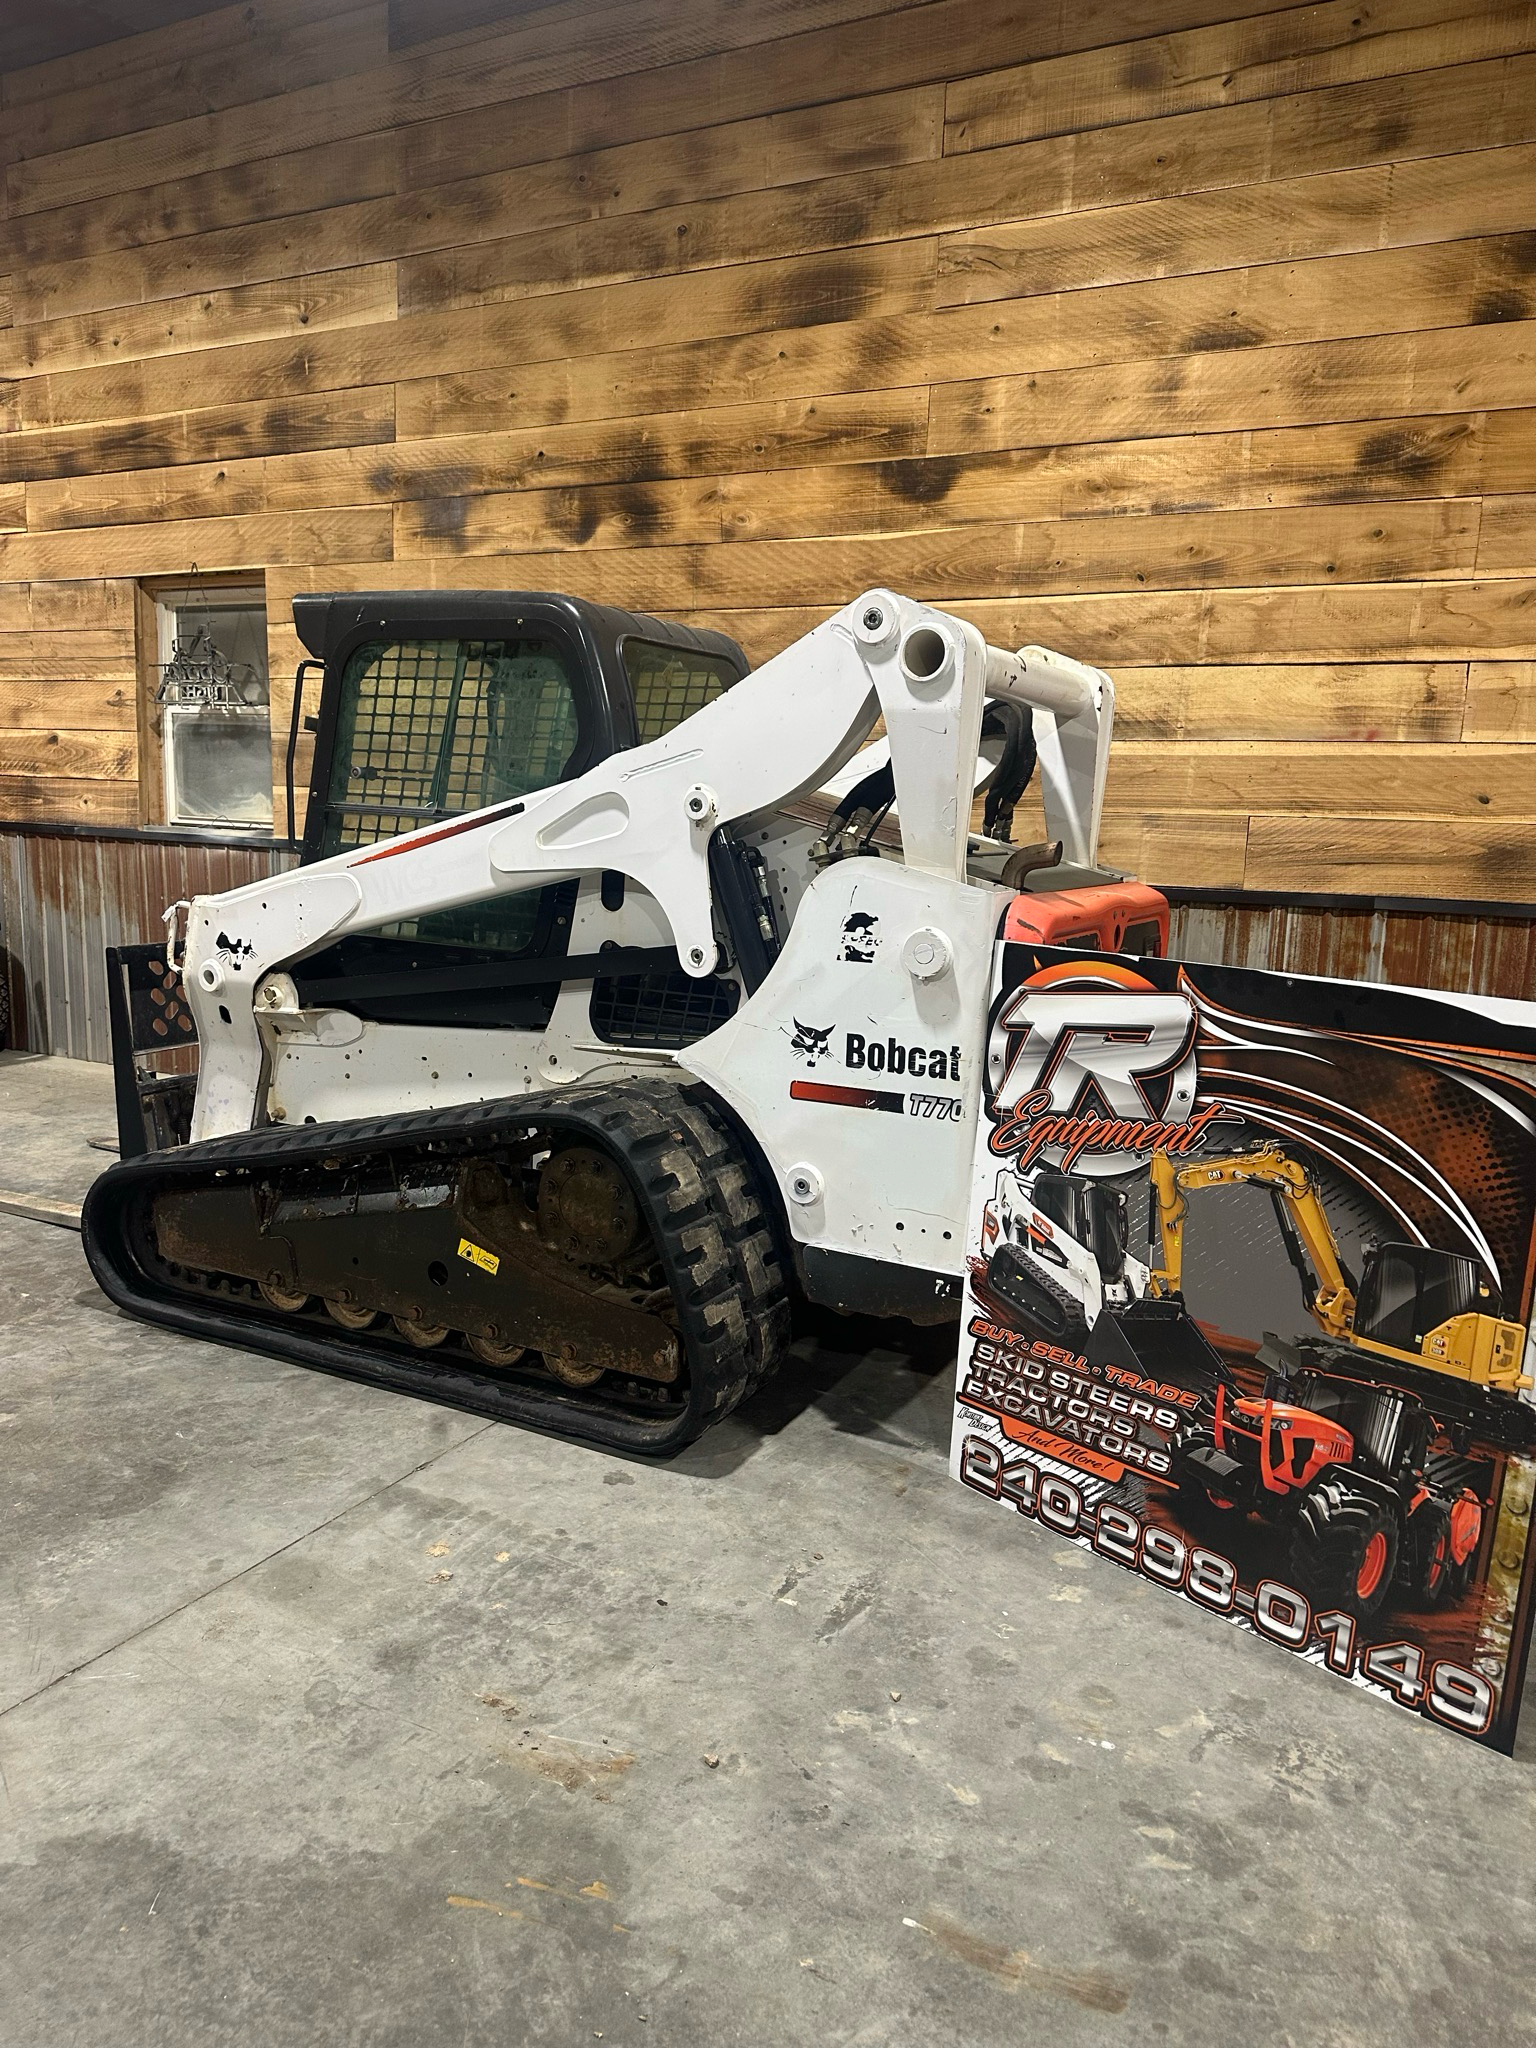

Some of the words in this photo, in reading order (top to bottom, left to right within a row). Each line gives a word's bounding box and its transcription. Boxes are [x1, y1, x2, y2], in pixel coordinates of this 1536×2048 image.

[846, 1033, 961, 1081] Bobcat
[994, 991, 1198, 1122] TR
[988, 1089, 1246, 1175] Equipment
[1207, 1169, 1224, 1181] CAT
[970, 1319, 1024, 1347] BUY
[1032, 1340, 1090, 1374] SELL
[1104, 1365, 1201, 1410] TRADE
[972, 1361, 1136, 1437] TRACTORS
[976, 1343, 1045, 1381] SKID
[1050, 1370, 1180, 1431] STEERS
[966, 1380, 1172, 1475] EXCAVATORS
[1011, 1429, 1052, 1449] And
[1055, 1440, 1114, 1472] More!
[964, 1437, 1494, 1732] 240-298-0149
